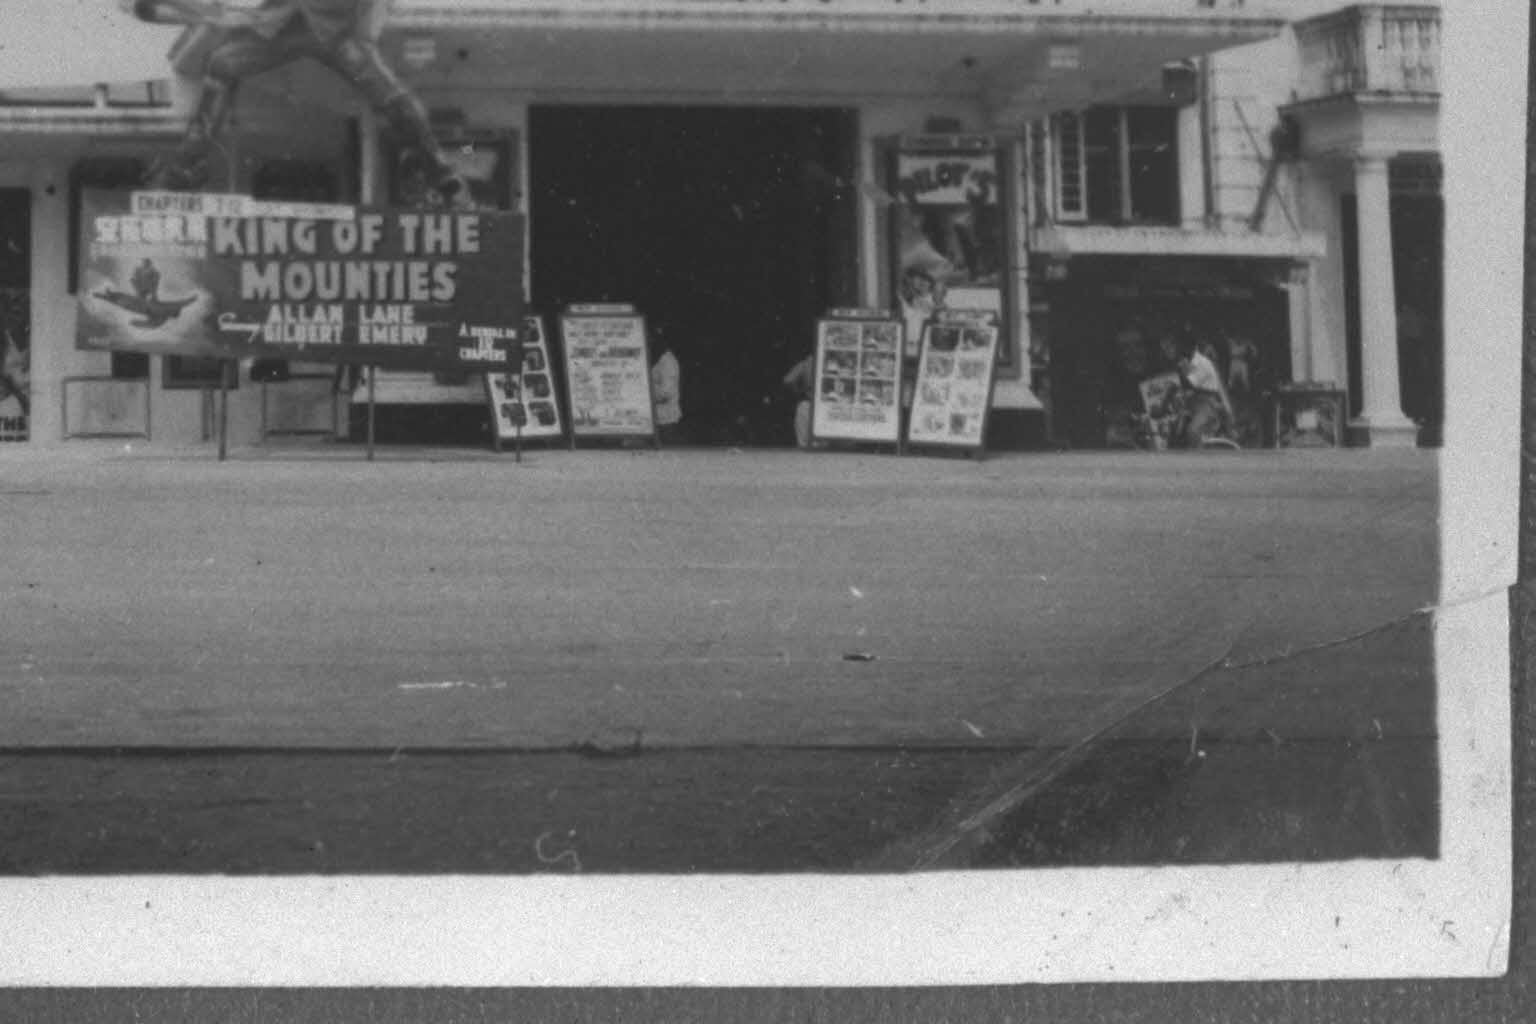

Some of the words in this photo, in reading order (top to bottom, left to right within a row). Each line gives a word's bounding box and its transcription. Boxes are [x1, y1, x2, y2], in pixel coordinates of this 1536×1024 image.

[214, 217, 316, 255] KING
[333, 215, 384, 254] OF
[400, 215, 480, 254] THE
[240, 260, 456, 302] MOUNTIES
[267, 304, 343, 325] ALLAN
[359, 304, 415, 324] LANE
[264, 323, 343, 346] GILBERT
